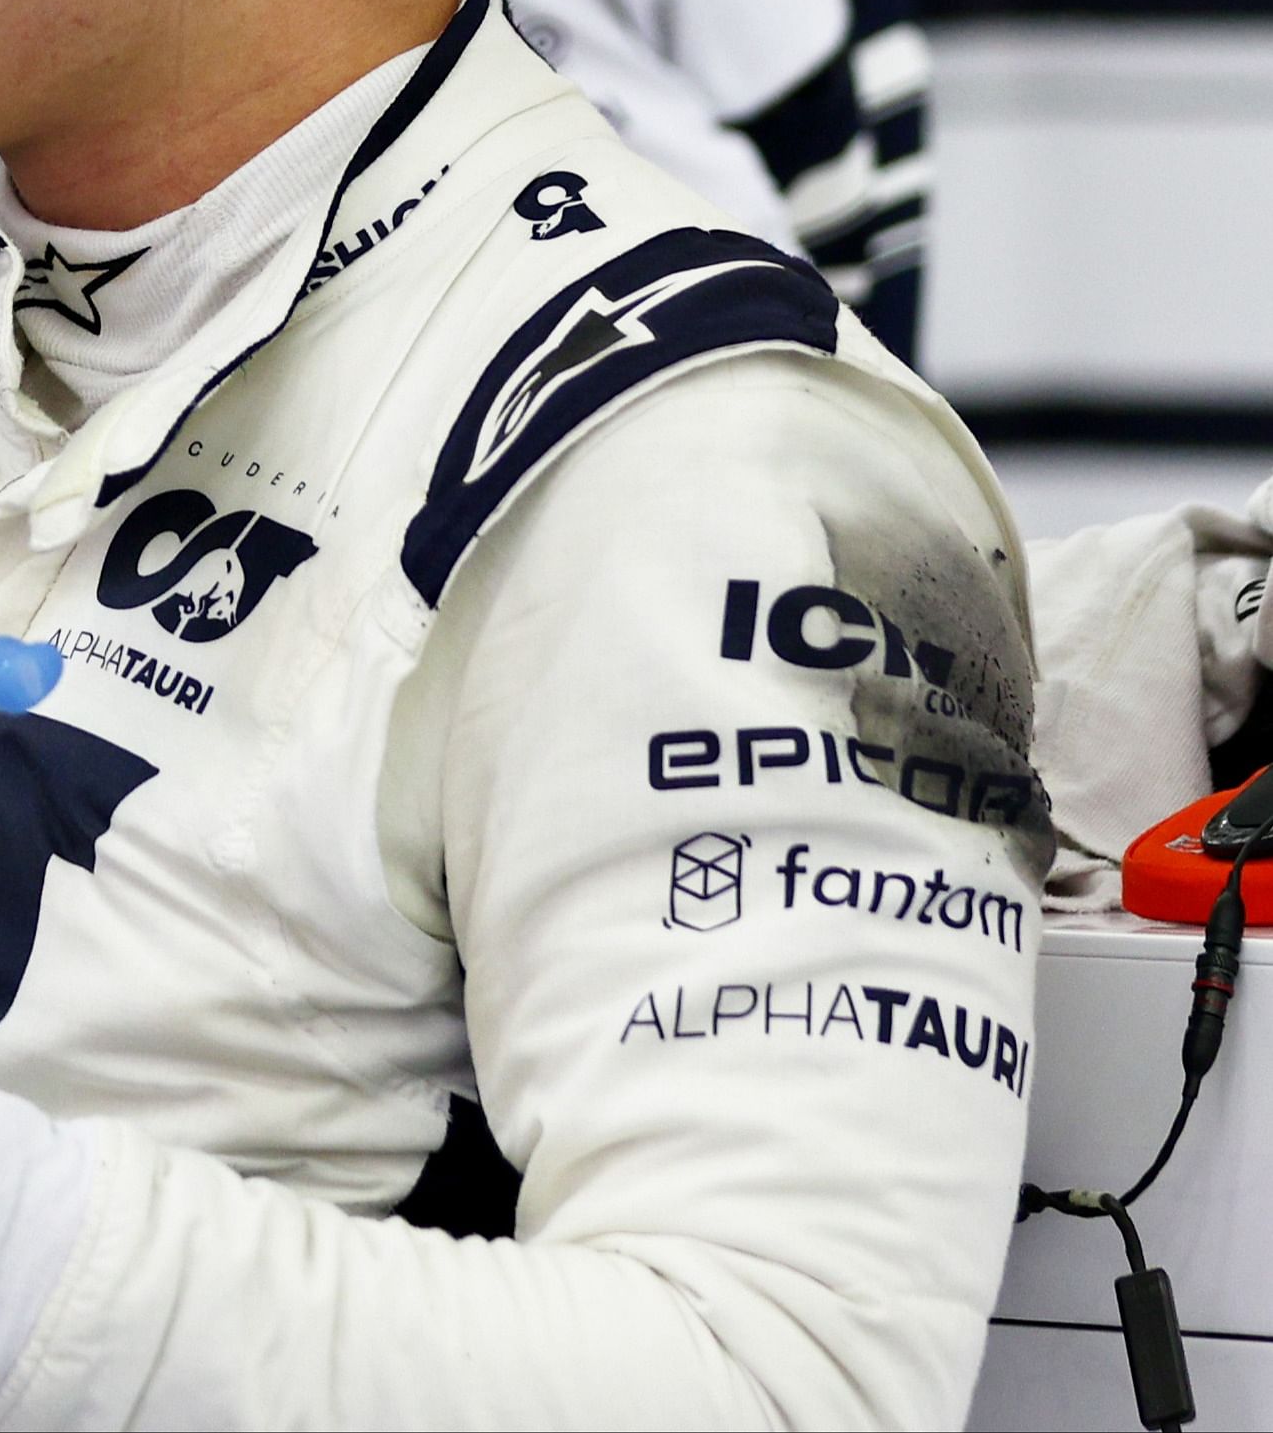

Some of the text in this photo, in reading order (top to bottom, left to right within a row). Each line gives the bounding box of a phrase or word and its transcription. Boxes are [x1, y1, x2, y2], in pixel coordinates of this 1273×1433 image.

[187, 439, 341, 519] CUDERIA
[775, 843, 1023, 953] fantom
[620, 981, 1030, 1099] ALPHATAURI
